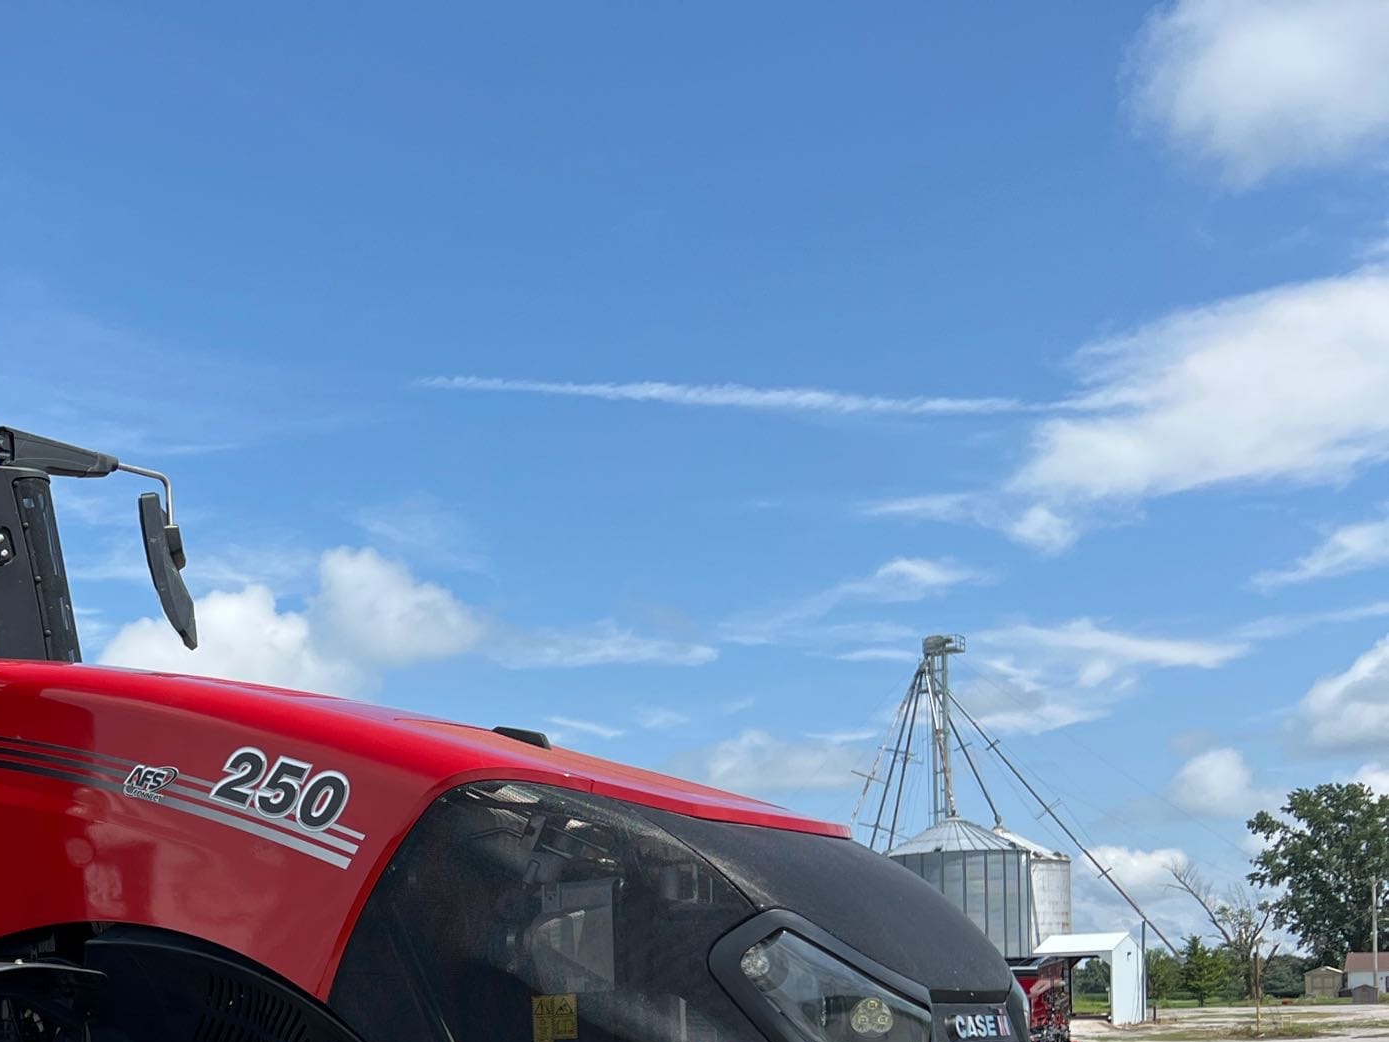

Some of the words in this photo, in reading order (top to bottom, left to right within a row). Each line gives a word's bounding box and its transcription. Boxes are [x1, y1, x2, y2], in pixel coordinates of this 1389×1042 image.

[123, 764, 169, 792] AFS
[208, 746, 350, 833] 250
[955, 1014, 997, 1039] CASE
